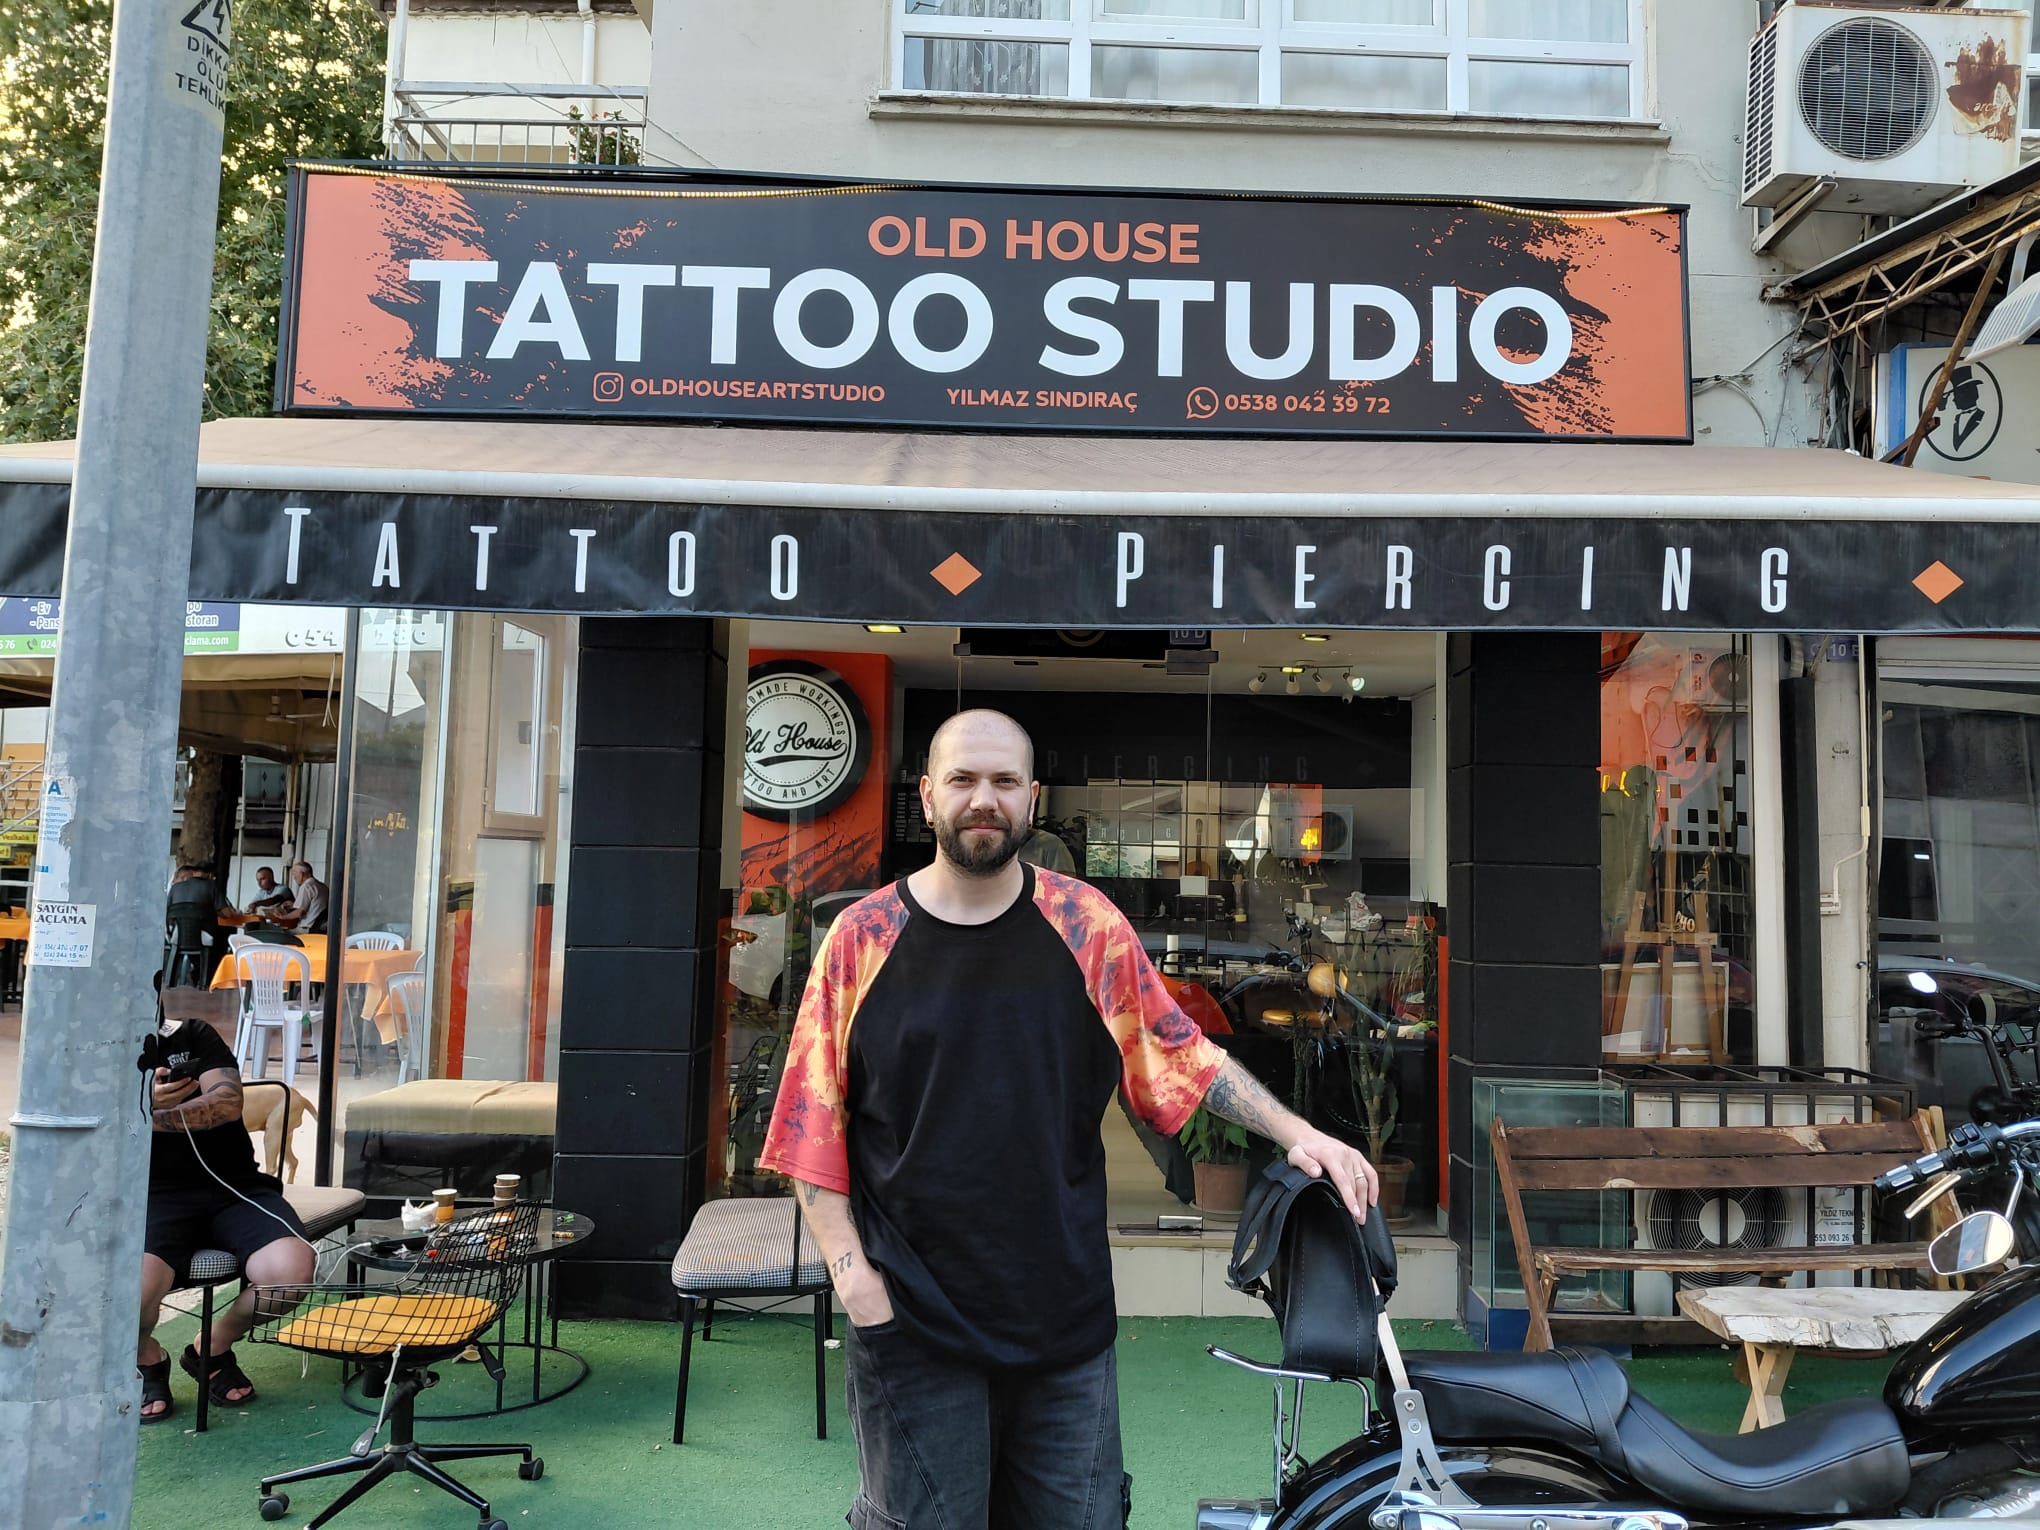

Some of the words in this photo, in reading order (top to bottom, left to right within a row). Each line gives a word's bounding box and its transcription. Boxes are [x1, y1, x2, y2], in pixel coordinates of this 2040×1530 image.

[867, 215, 987, 259] OLD
[1005, 219, 1201, 264] HOUSE
[408, 259, 994, 373] TATTOO
[1038, 276, 1573, 385] STUDIO
[630, 378, 885, 402] OLDHOUSEARTSTUDIO
[946, 388, 1029, 408] YILMAZ
[1036, 390, 1138, 414] SINDIRAÇ
[1225, 394, 1277, 412] 0538
[1284, 395, 1326, 413] 042
[1332, 397, 1358, 413] 39
[1365, 397, 1390, 414] 72
[284, 507, 798, 601] TATTOO
[1116, 531, 1789, 614] PIERCING
[773, 721, 843, 754] House
[782, 786, 807, 799] AND
[815, 767, 836, 789] ART
